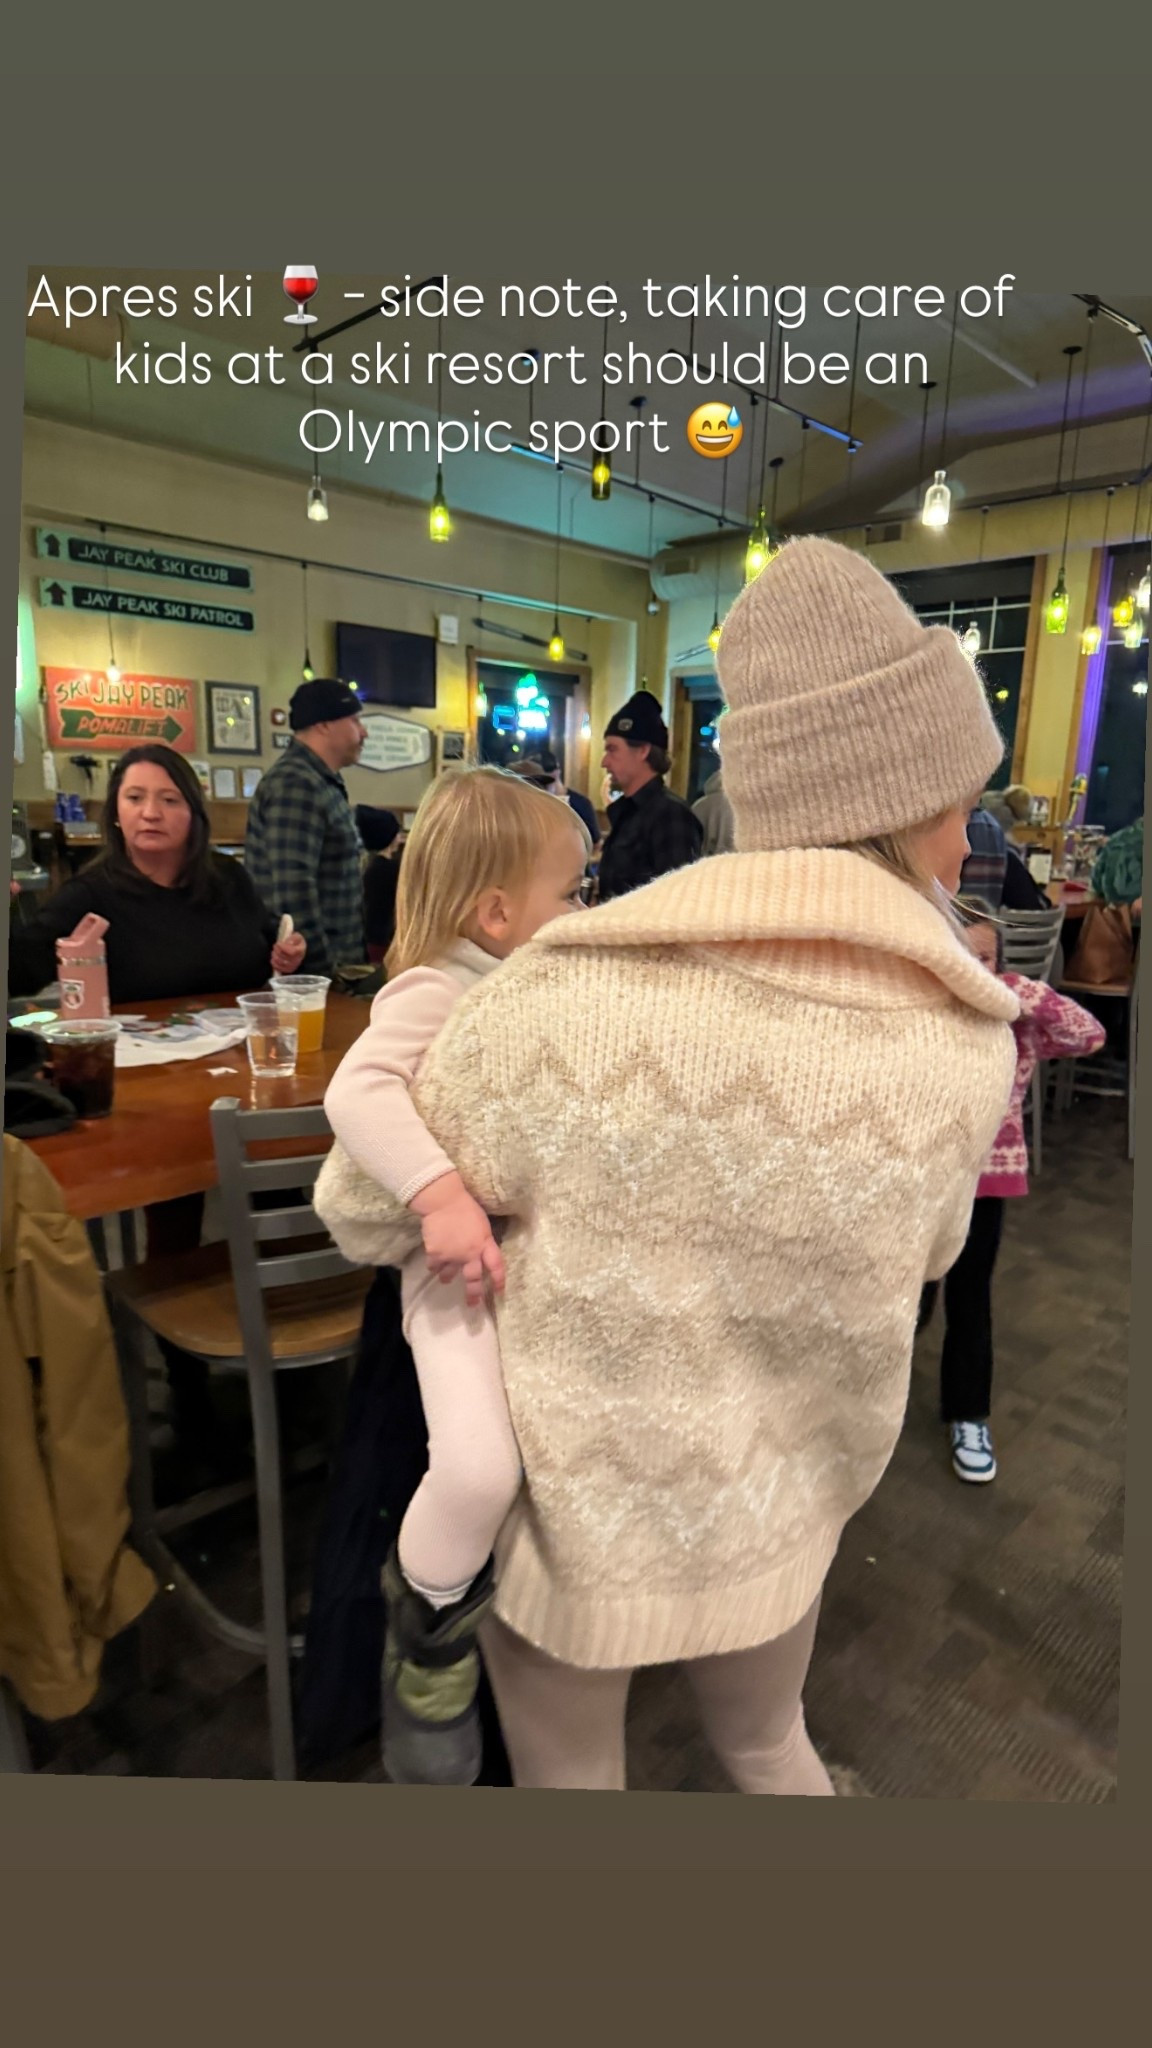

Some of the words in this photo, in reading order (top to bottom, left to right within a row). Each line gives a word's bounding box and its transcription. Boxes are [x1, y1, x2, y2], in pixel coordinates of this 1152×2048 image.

[78, 546, 109, 561] JAY
[114, 553, 156, 570] PEAK
[161, 559, 185, 575] SKI
[189, 564, 229, 582] CLUB
[81, 592, 113, 607] JAY
[117, 598, 159, 615] PEAK
[163, 603, 186, 619] SKI
[190, 607, 244, 626] PATROL
[93, 679, 135, 706] JAY
[140, 685, 189, 710] PEAK
[76, 717, 168, 737] POMALIFT
